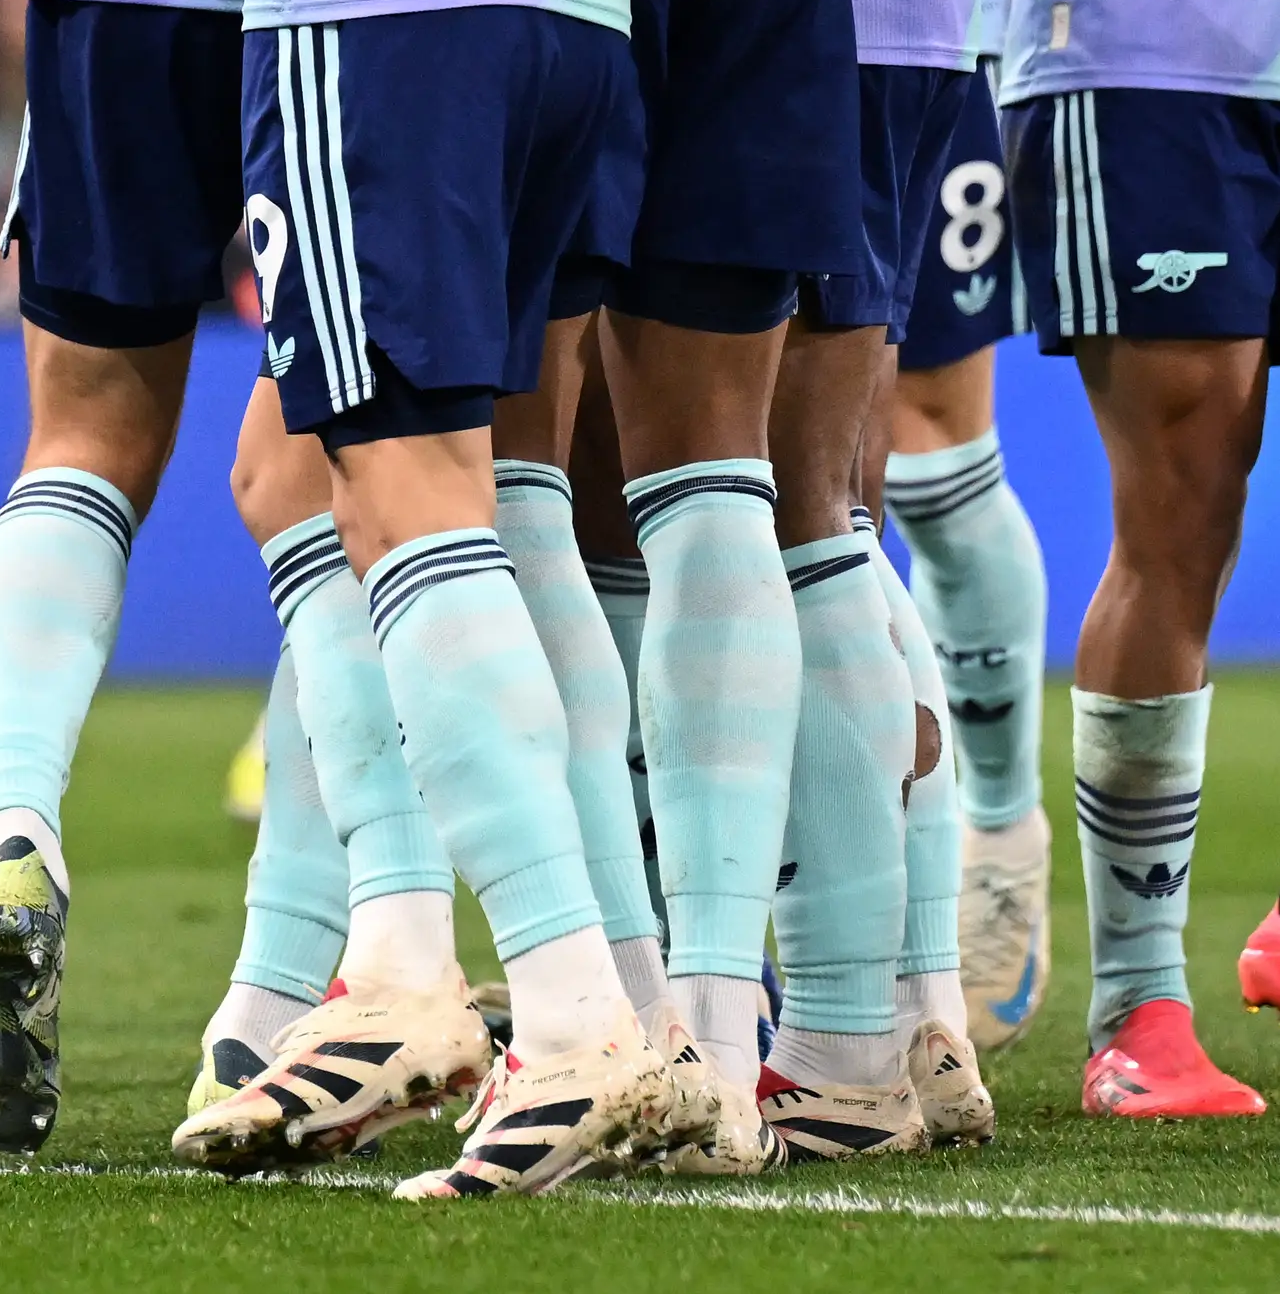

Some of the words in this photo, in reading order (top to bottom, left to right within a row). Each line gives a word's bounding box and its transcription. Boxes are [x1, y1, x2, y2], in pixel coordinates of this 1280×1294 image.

[939, 160, 1005, 273] 8
[531, 1068, 577, 1086] PREDATOR
[832, 1097, 878, 1108] PREDATOR
